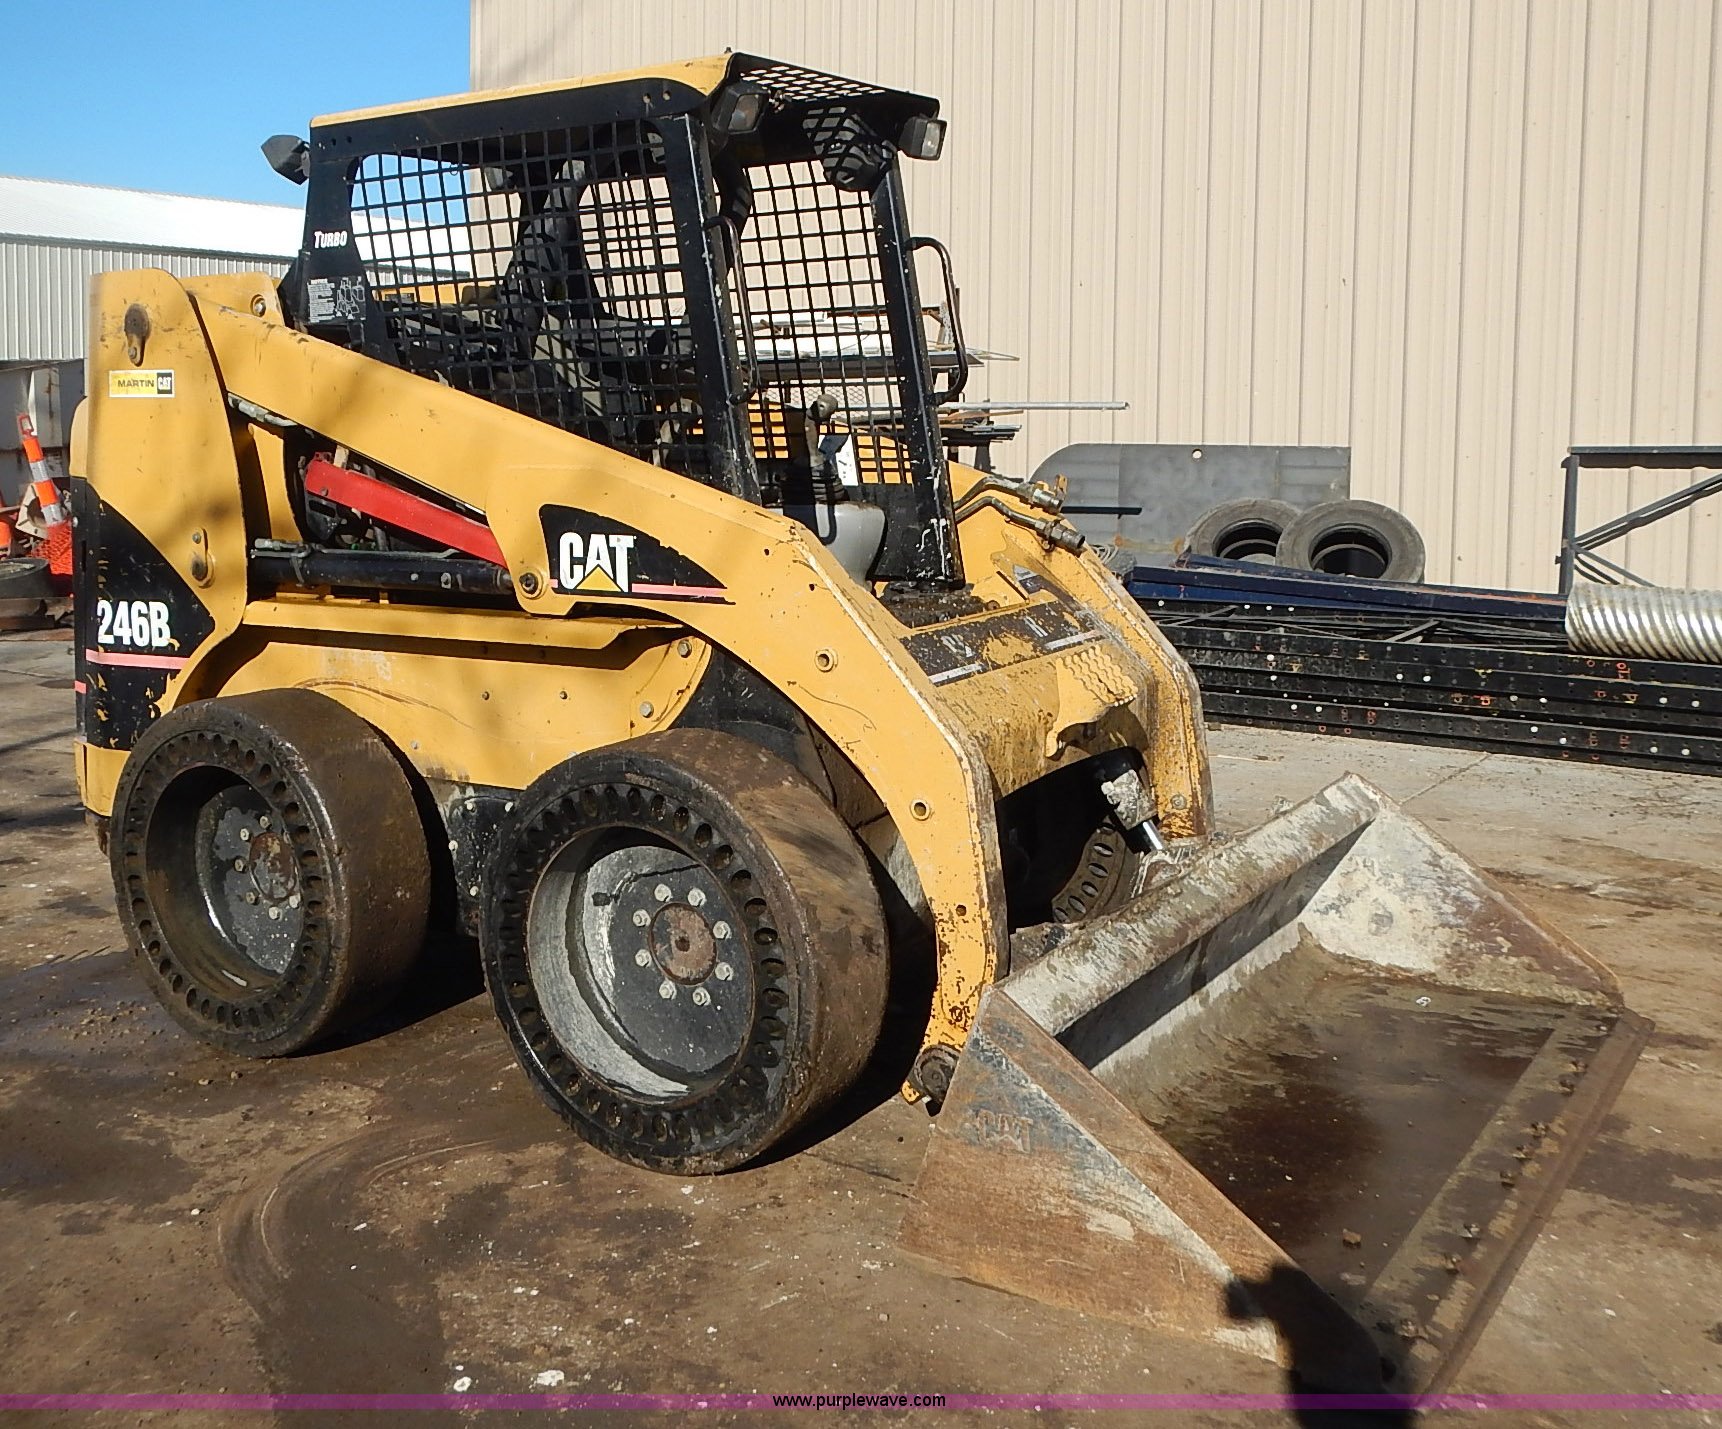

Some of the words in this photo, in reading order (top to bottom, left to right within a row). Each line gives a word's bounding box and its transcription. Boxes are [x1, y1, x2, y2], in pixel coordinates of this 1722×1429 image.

[314, 230, 348, 249] TURBO
[117, 379, 155, 388] MARTIN
[157, 376, 172, 391] CAT
[559, 531, 635, 593] CAT
[97, 599, 171, 647] 246B
